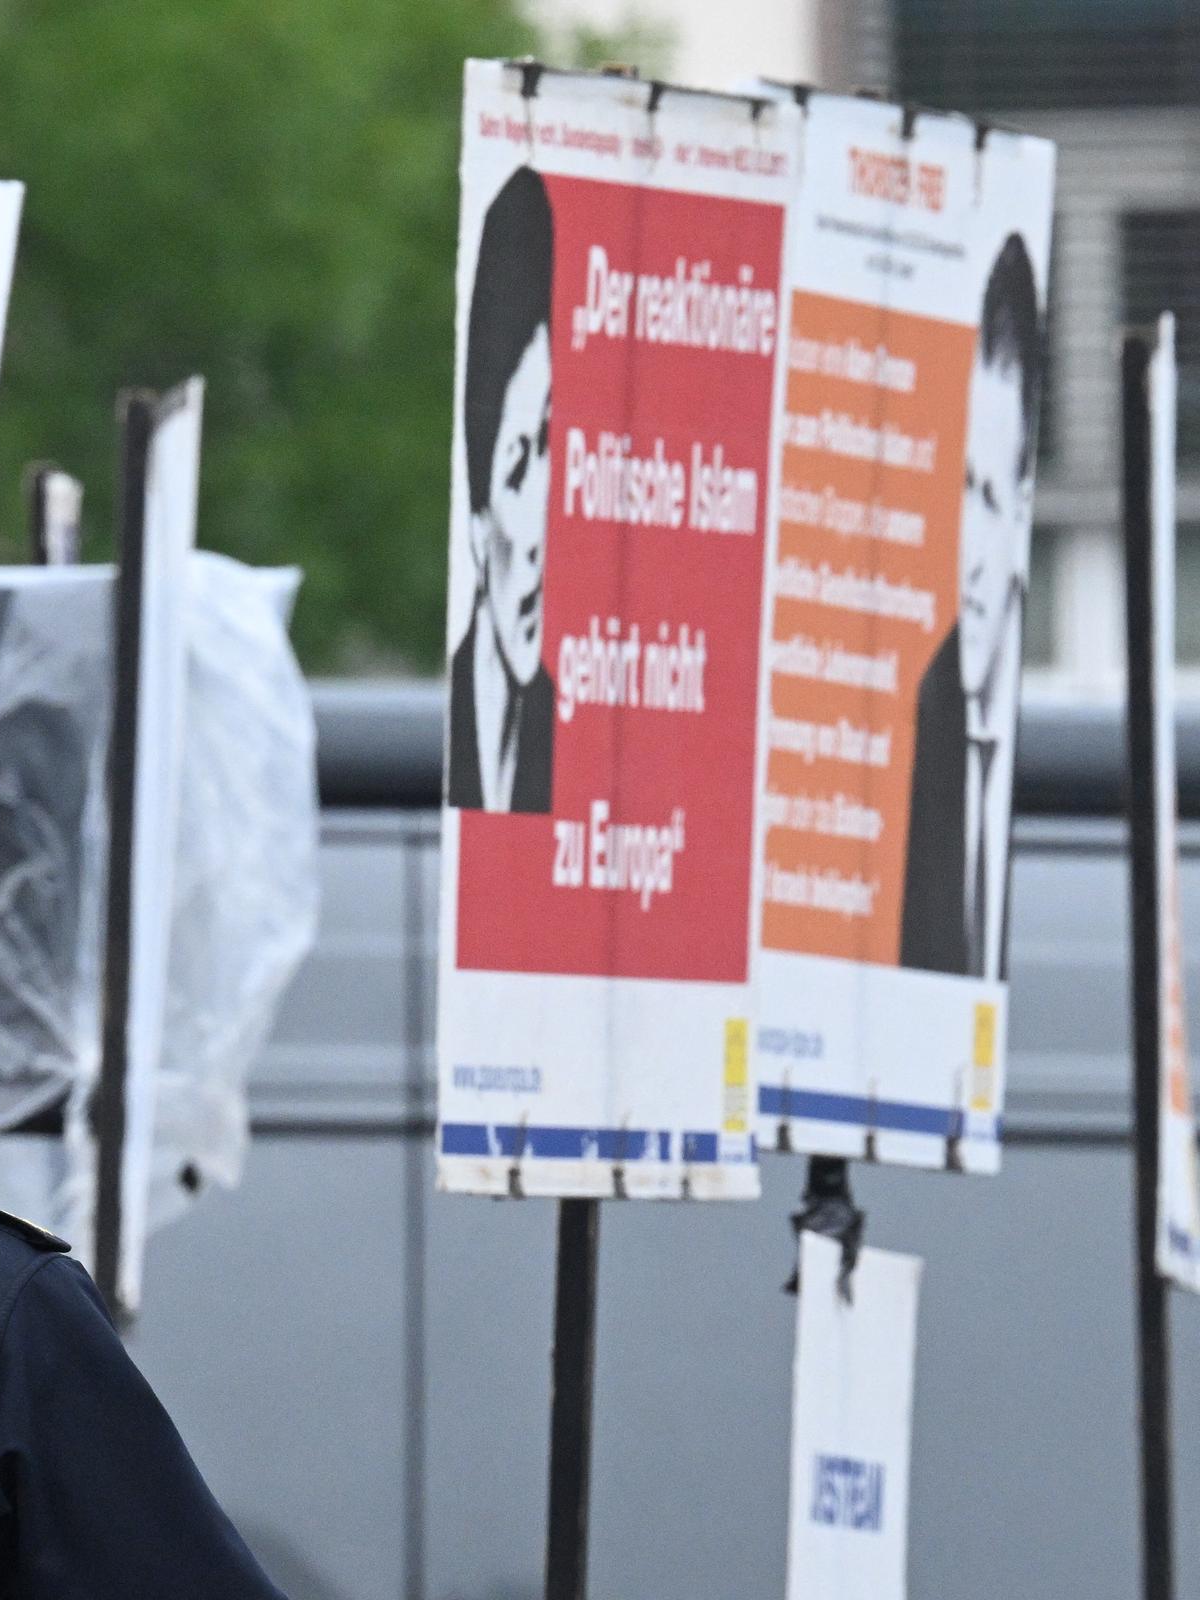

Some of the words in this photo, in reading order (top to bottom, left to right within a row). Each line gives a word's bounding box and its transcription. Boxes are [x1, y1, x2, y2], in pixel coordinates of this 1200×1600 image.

[636, 257, 776, 357] reaktionäre
[565, 427, 686, 529] Politische
[688, 443, 758, 534] Islam
[557, 615, 640, 723] gehört
[642, 622, 707, 714] nicht
[553, 819, 585, 887] zu
